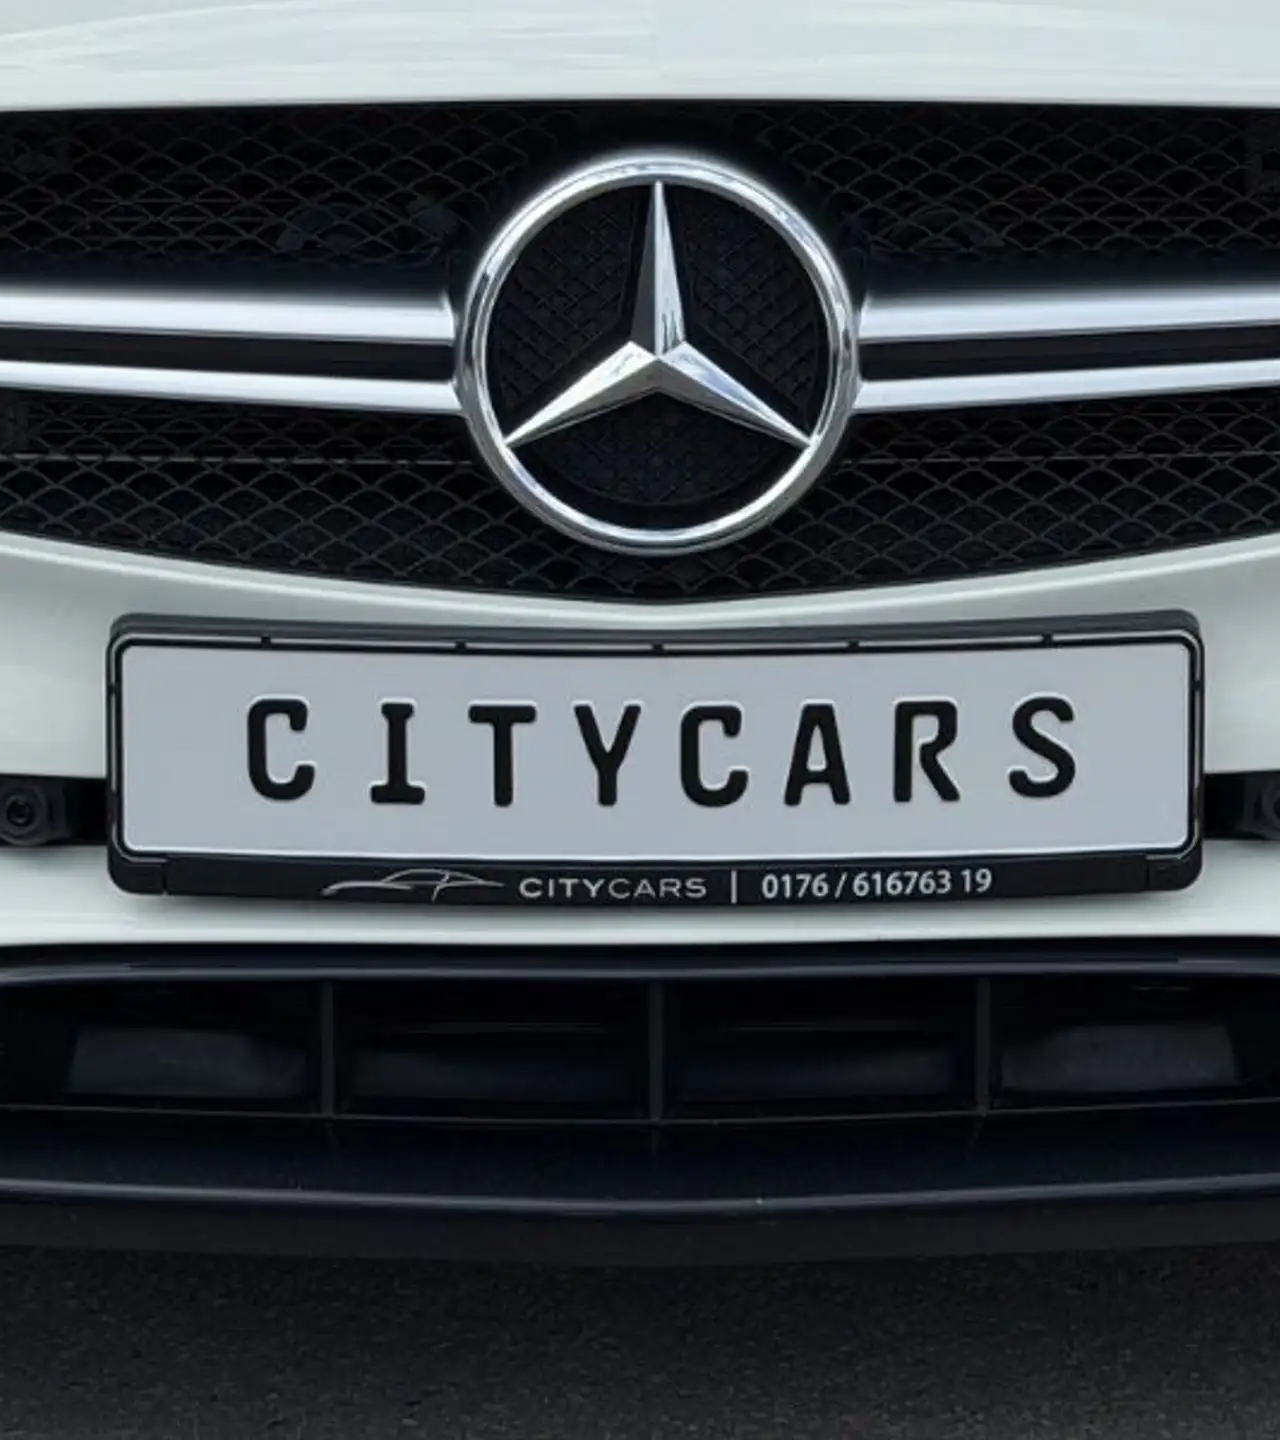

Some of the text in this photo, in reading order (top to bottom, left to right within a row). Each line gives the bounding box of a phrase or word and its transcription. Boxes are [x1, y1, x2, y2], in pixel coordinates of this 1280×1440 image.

[246, 696, 1077, 809] CITYCARS
[518, 876, 708, 900] CITYCARS
[851, 868, 953, 898] 616763
[960, 867, 993, 894] 19
